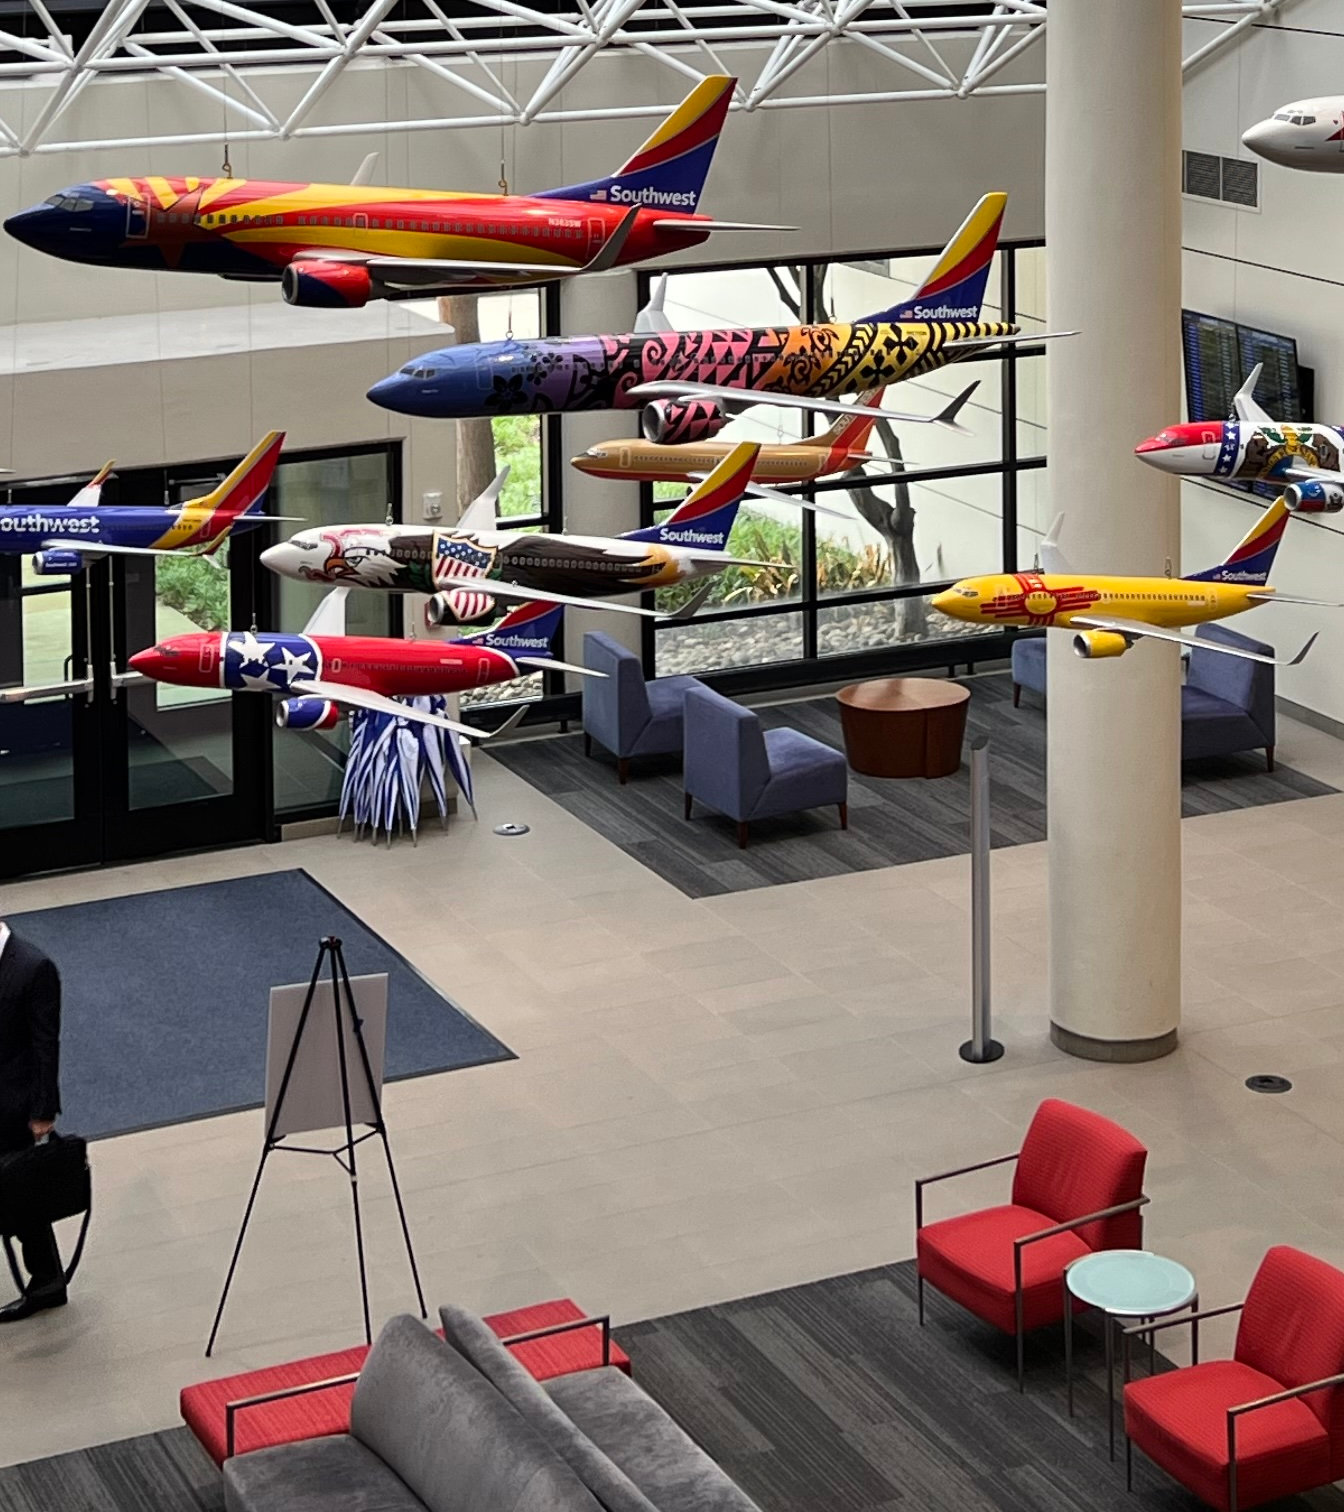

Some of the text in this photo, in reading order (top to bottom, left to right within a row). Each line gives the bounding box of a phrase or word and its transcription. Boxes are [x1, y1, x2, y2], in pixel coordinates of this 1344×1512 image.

[610, 185, 697, 206] Southwest
[913, 305, 978, 319] Southwest
[659, 528, 725, 545] Southwest
[1221, 570, 1267, 581] Southwest
[485, 634, 549, 648] Southwest
